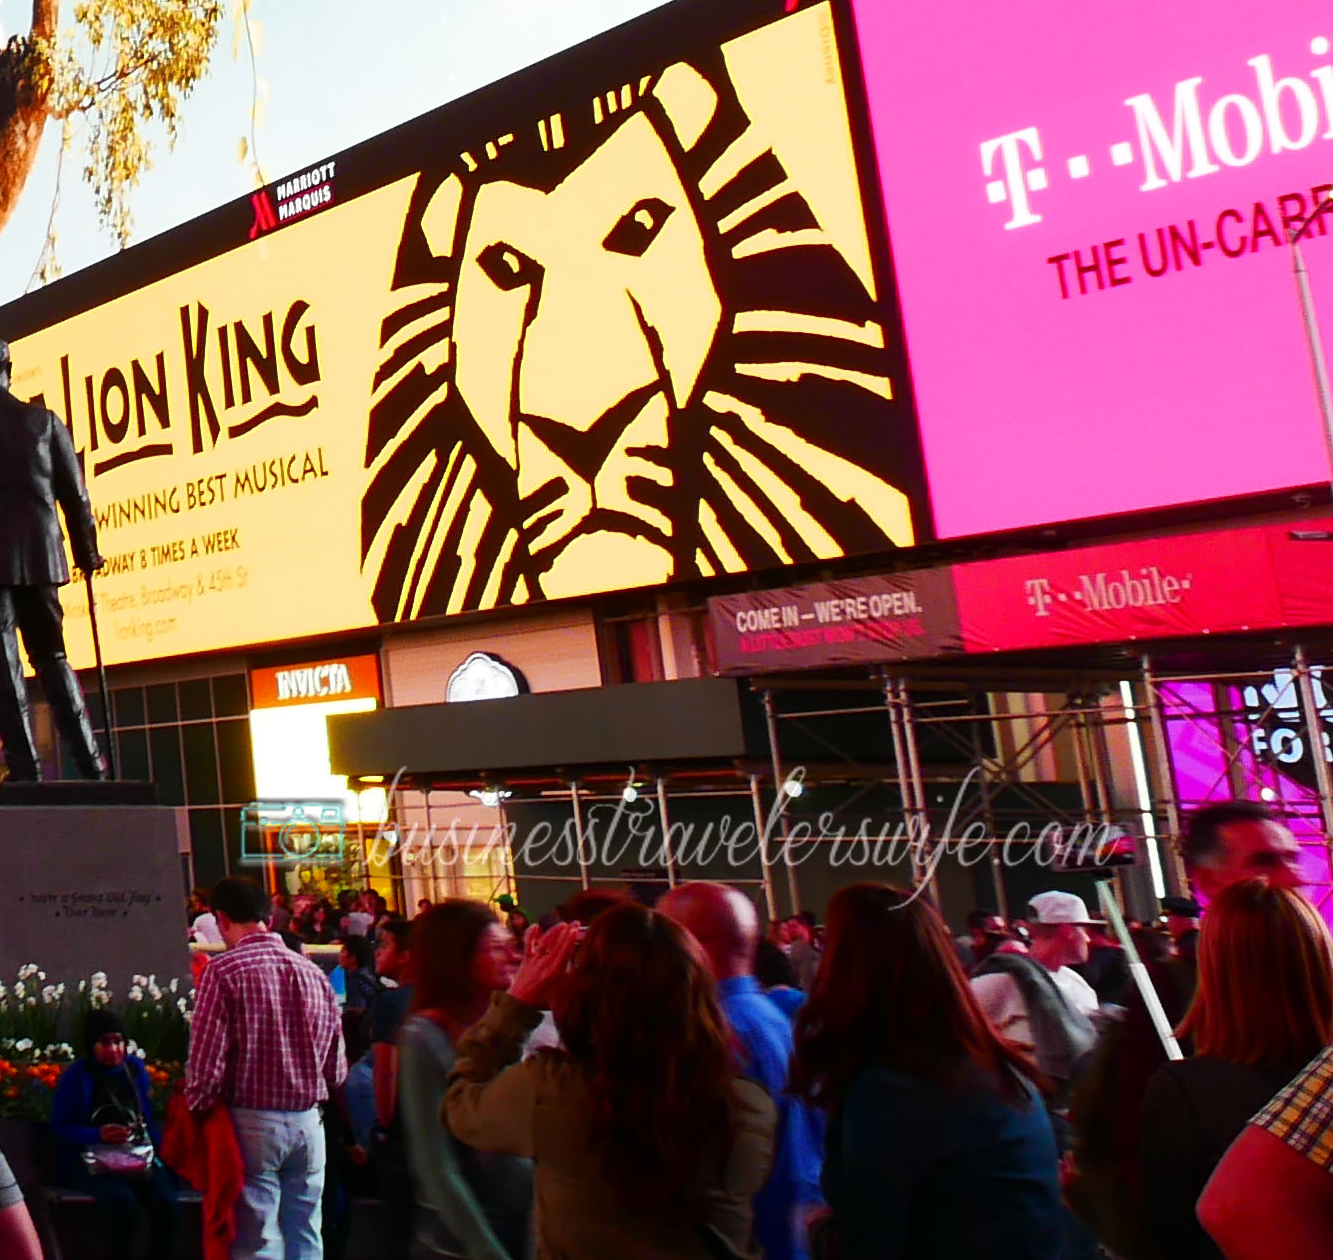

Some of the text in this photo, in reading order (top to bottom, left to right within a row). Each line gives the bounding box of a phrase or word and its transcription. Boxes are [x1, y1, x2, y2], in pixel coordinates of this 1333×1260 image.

[276, 160, 337, 201] MARRIOTT
[278, 184, 332, 221] MARQUIS
[1046, 238, 1133, 300] THE
[60, 298, 322, 475] LION KING
[186, 471, 228, 511] BEST
[233, 447, 330, 501] MUSICAL
[151, 540, 185, 567] TIMES
[190, 538, 199, 559] A
[202, 527, 241, 555] WEEK
[735, 590, 923, 633] COME IN WE'RE OPEN.
[274, 663, 353, 702] INVICTA
